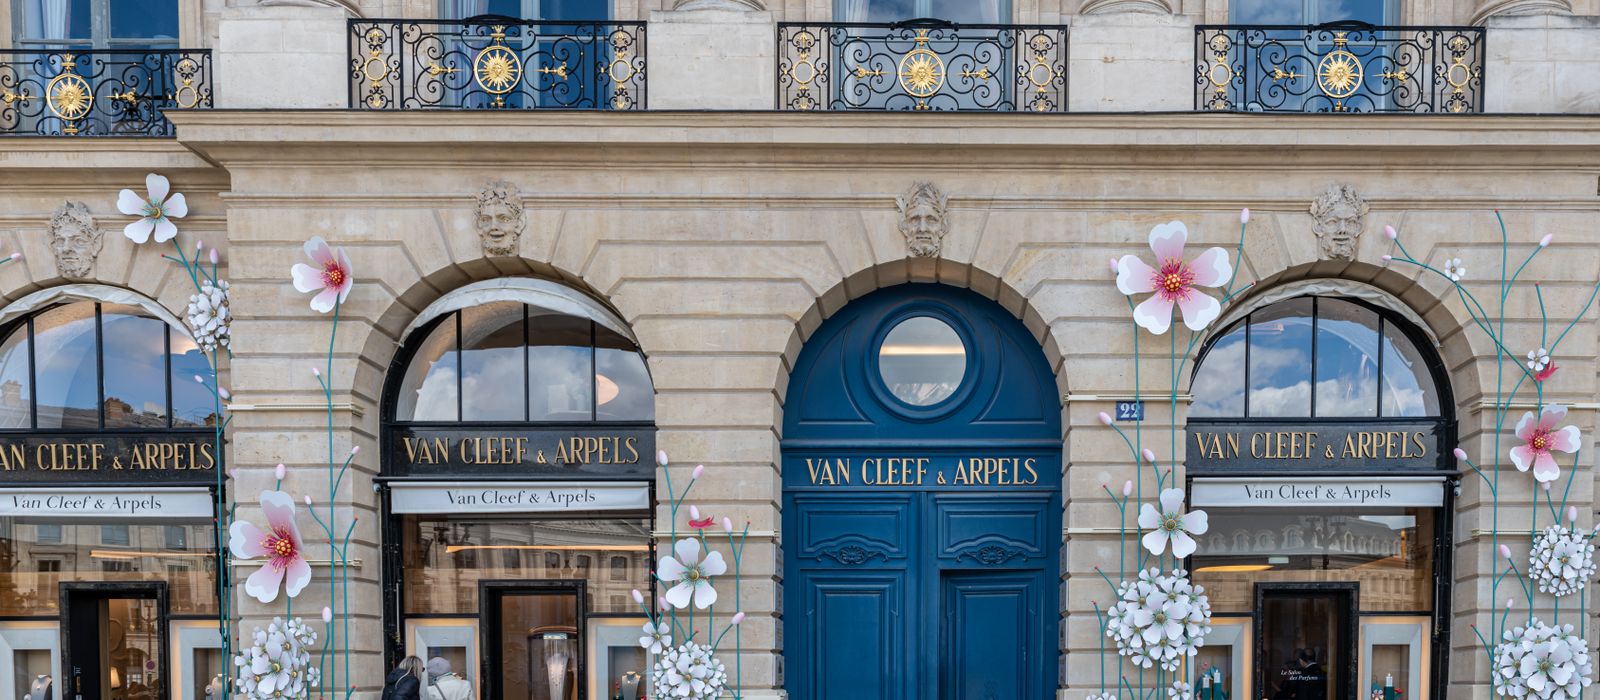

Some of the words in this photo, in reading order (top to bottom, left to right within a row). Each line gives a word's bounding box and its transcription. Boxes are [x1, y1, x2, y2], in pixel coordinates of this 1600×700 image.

[1120, 402, 1140, 418] 22
[403, 437, 450, 464] VAN
[461, 437, 529, 464] CLEEF
[537, 450, 547, 464] &
[554, 437, 640, 464] ARPELS
[1195, 432, 1240, 459] VAN
[1251, 432, 1318, 459] CLEEF
[1325, 445, 1335, 459] &
[1342, 431, 1427, 458] ARPELS
[0, 443, 26, 471] AN
[37, 443, 105, 471] CLEEF
[113, 456, 124, 470] &
[130, 443, 215, 470] ARPELS
[806, 458, 850, 485] VAN
[862, 458, 930, 485] CLEEF
[937, 471, 947, 485] &
[953, 458, 1038, 485] ARPELS
[13, 495, 41, 509] Van
[46, 495, 91, 509] Cleef
[94, 499, 105, 509] &
[112, 495, 162, 514] Arpels
[447, 490, 476, 505] Van
[481, 489, 526, 504] Cleef
[529, 493, 540, 504] &
[545, 489, 596, 508] Arpels
[1244, 485, 1273, 499] Van
[1279, 485, 1321, 499] Cleef
[1326, 489, 1337, 499] &
[1342, 485, 1391, 503] Arpels
